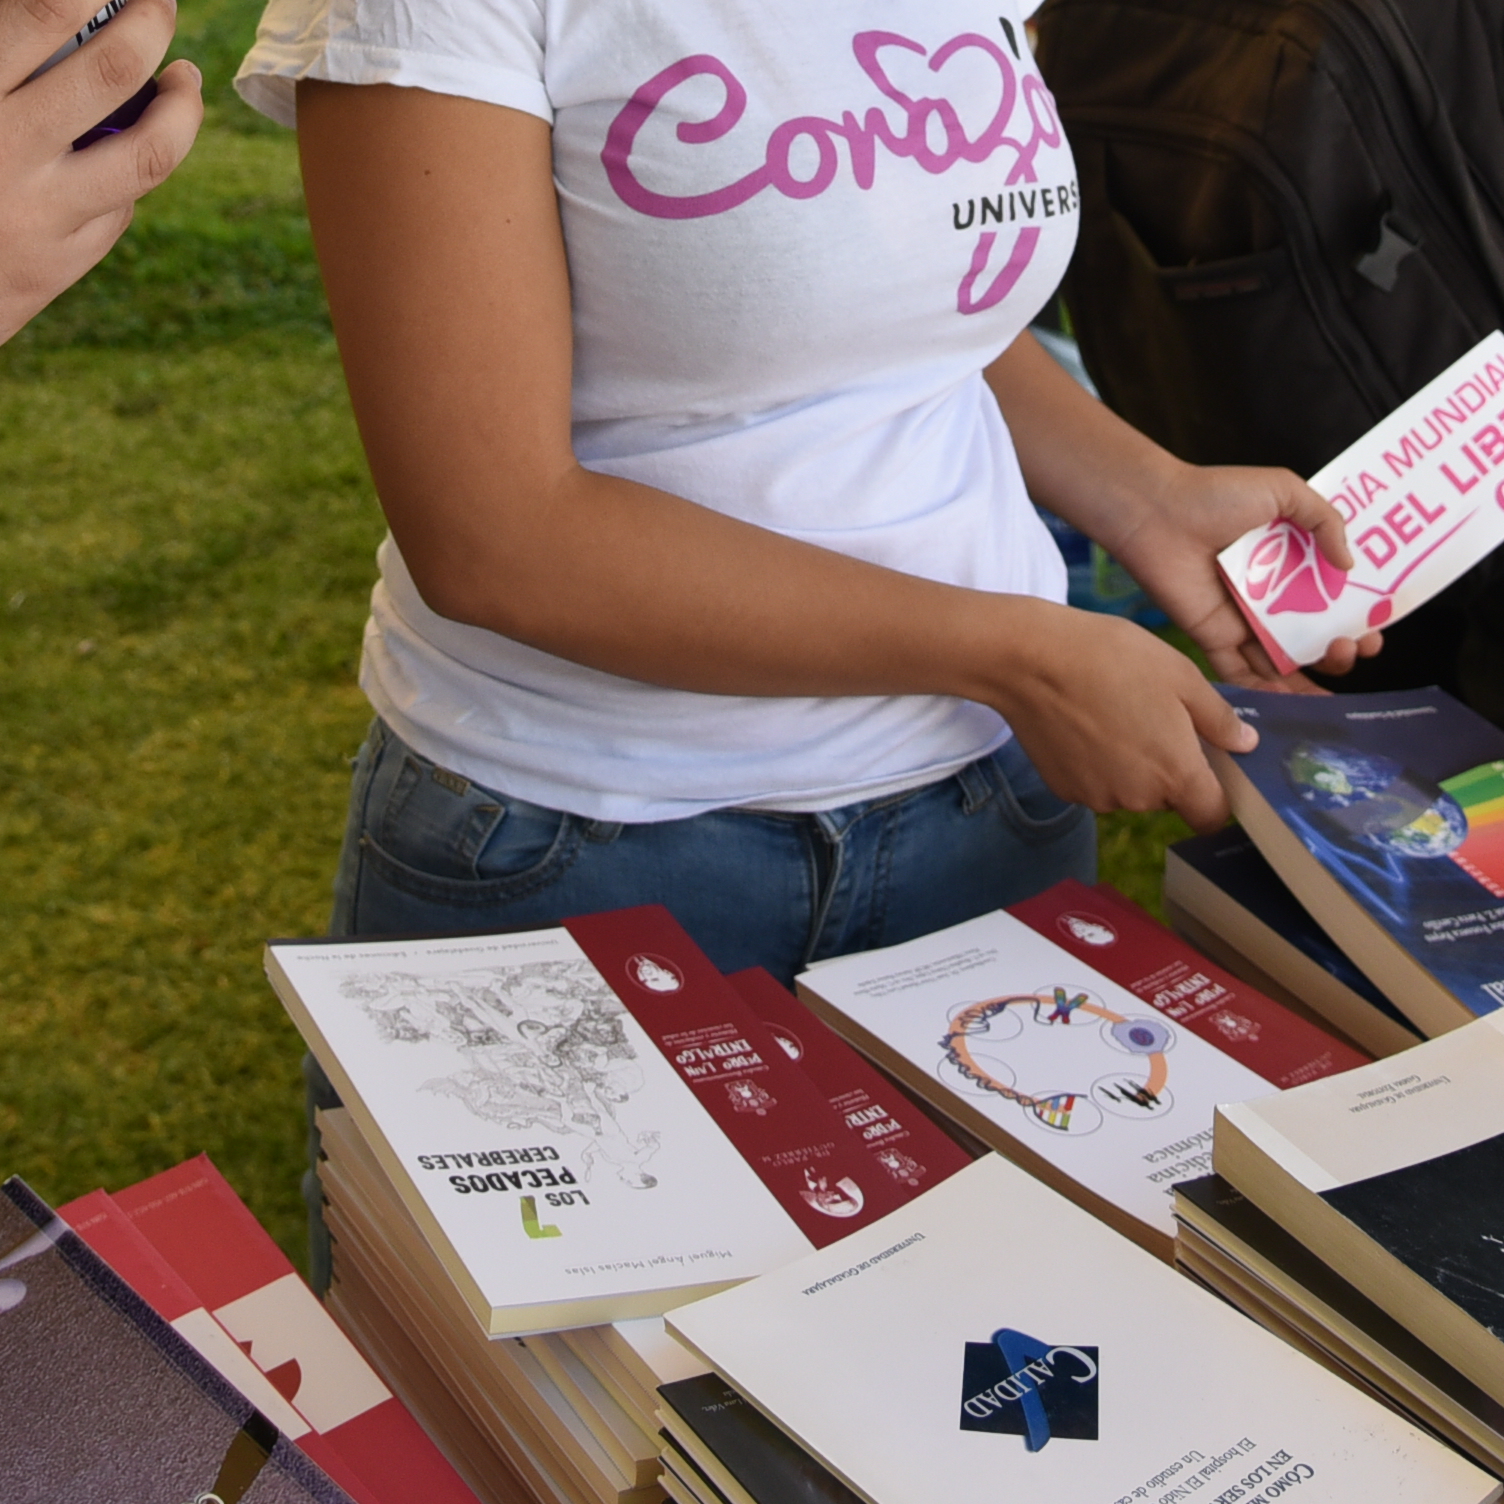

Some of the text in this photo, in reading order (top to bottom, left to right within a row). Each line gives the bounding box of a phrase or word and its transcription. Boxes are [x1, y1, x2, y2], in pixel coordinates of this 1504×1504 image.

[1355, 491, 1447, 571] DEL
[417, 1145, 560, 1170] CEREBRALES
[1146, 1152, 1213, 1184] edicina
[449, 1167, 579, 1195] PECADOS
[520, 1190, 591, 1240] LOS 7
[597, 1260, 645, 1275] Macías
[688, 1249, 734, 1264] Miguel
[801, 1232, 927, 1296] UNIVERSIDAD DE GUADALAJARA
[564, 1266, 596, 1278] Islas
[963, 1346, 1098, 1418] CALIDAD
[1181, 1449, 1206, 1465] Un
[1236, 1437, 1256, 1453] El
[1198, 1446, 1240, 1481] hospital
[1265, 1448, 1293, 1471] EN
[1145, 1460, 1184, 1490] estudio
[1184, 1474, 1206, 1491] El
[1240, 1464, 1268, 1490] LOS
[1264, 1462, 1315, 1498] CÓMO
[1131, 1485, 1150, 1499] de
